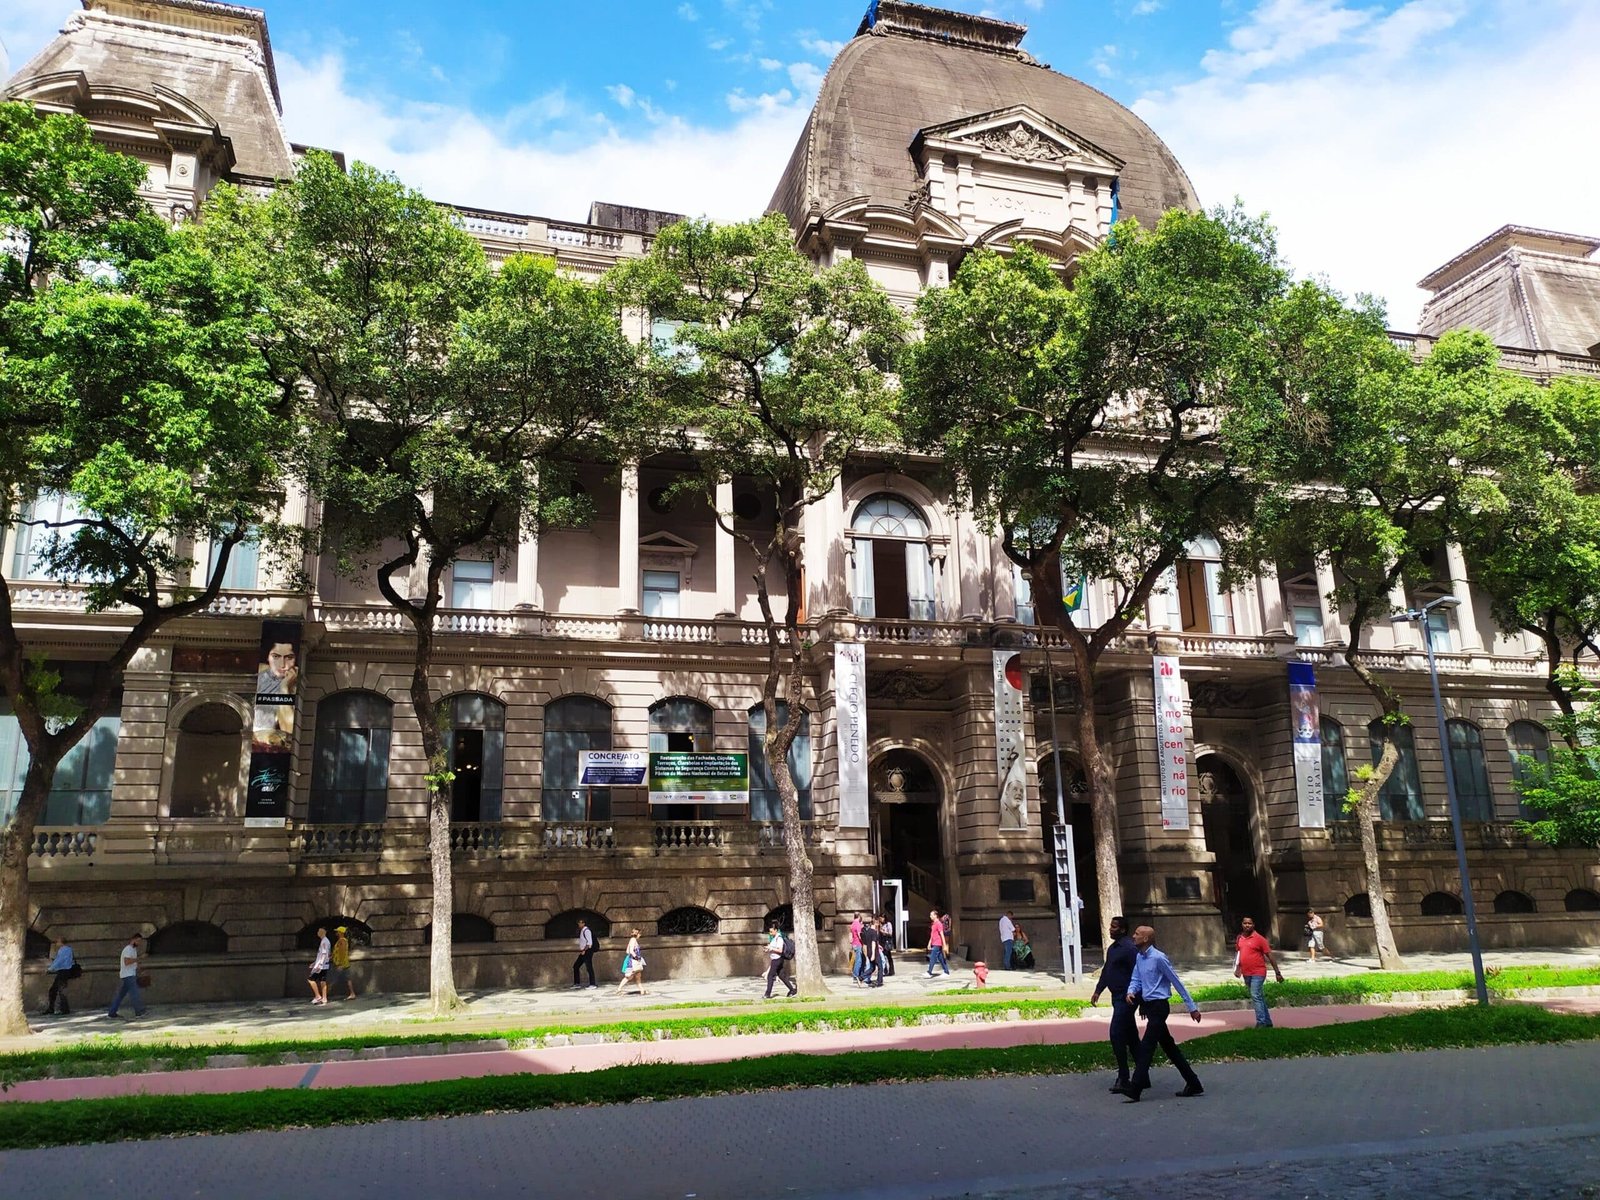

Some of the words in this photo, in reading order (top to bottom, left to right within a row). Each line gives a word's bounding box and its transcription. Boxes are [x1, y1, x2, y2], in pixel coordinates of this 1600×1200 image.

[1169, 694, 1180, 703] ru
[1165, 709, 1182, 719] mo
[1169, 724, 1182, 734] ao
[849, 716, 860, 763] PENEDO
[1164, 739, 1183, 749] cen
[1173, 755, 1184, 765] te
[1173, 770, 1185, 780] ná
[1313, 759, 1322, 803] PARATY
[1171, 786, 1186, 796] rio
